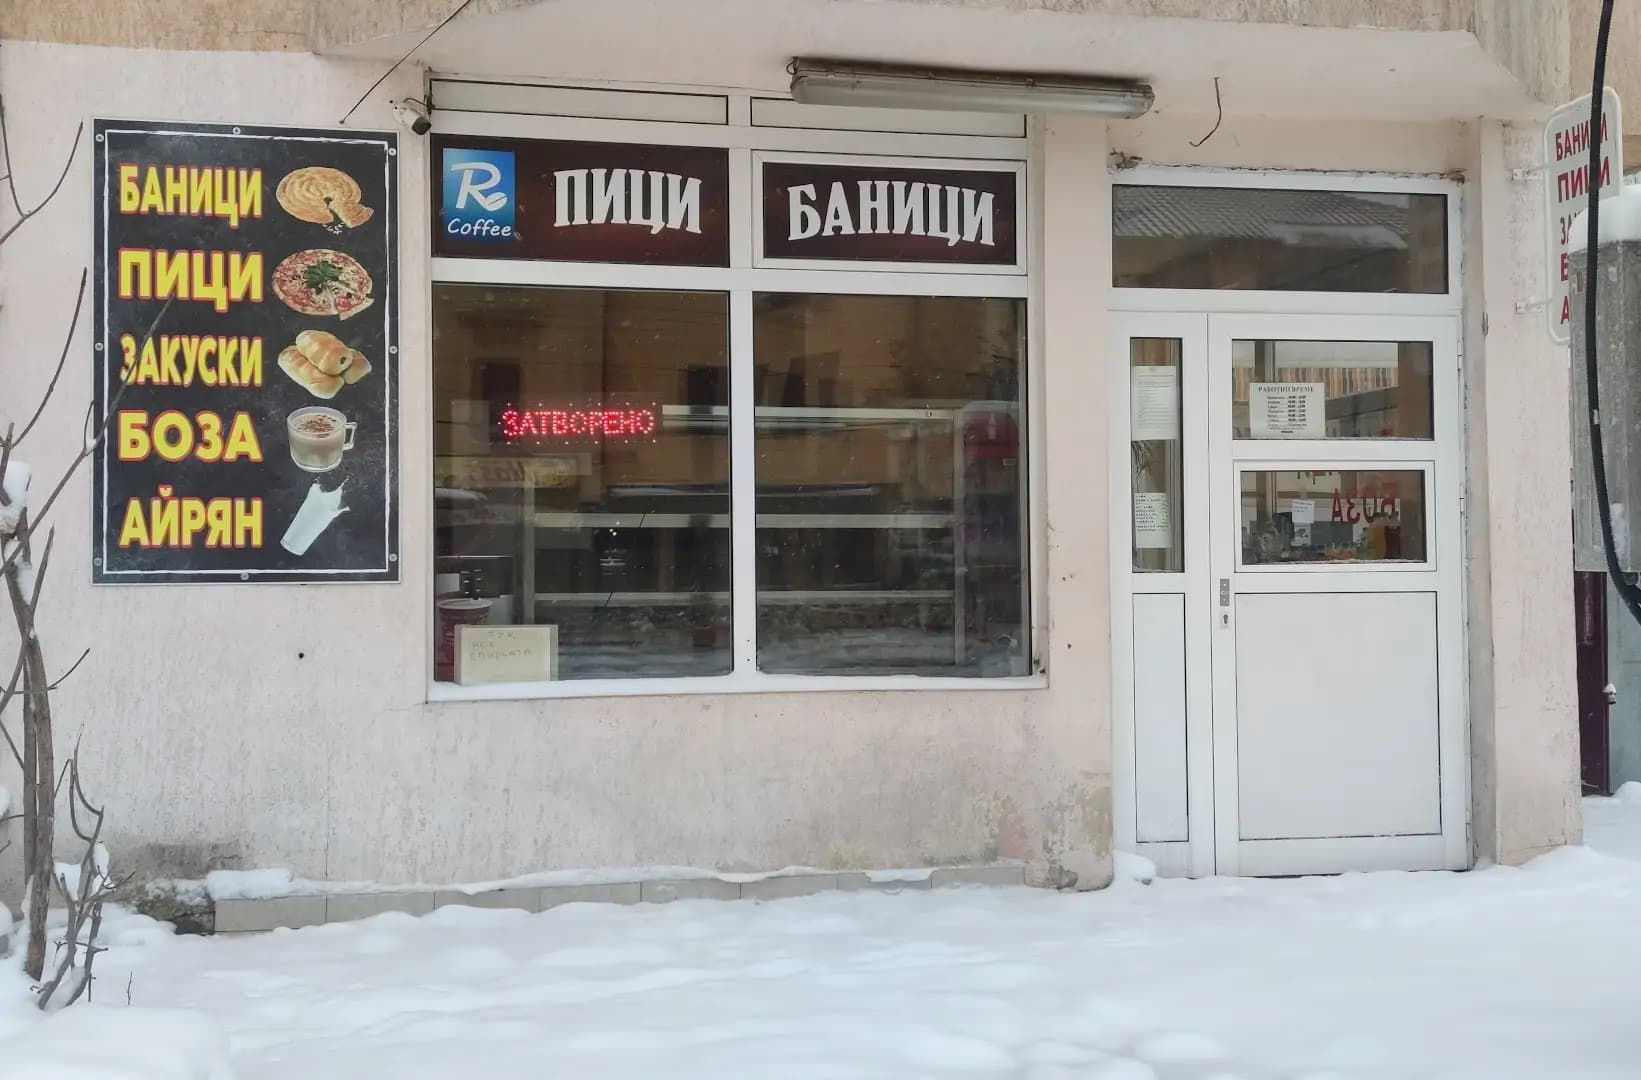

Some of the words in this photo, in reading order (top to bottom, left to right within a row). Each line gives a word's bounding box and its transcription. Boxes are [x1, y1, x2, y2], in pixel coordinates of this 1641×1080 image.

[1555, 113, 1607, 161] БАНИИ
[119, 164, 263, 227] БАНИЦИ
[553, 168, 702, 234] ПИЦИ
[1558, 156, 1610, 203] ПИИ
[447, 216, 512, 237] Coffee
[787, 181, 997, 246] БАНИЦИ
[118, 248, 264, 313] ПИЦИ
[118, 334, 264, 387] ЗАКУСКИ
[118, 409, 264, 464] БОЗА
[502, 410, 655, 436] ЗАТВОРЕНО
[119, 484, 264, 549] АЙРЯН
